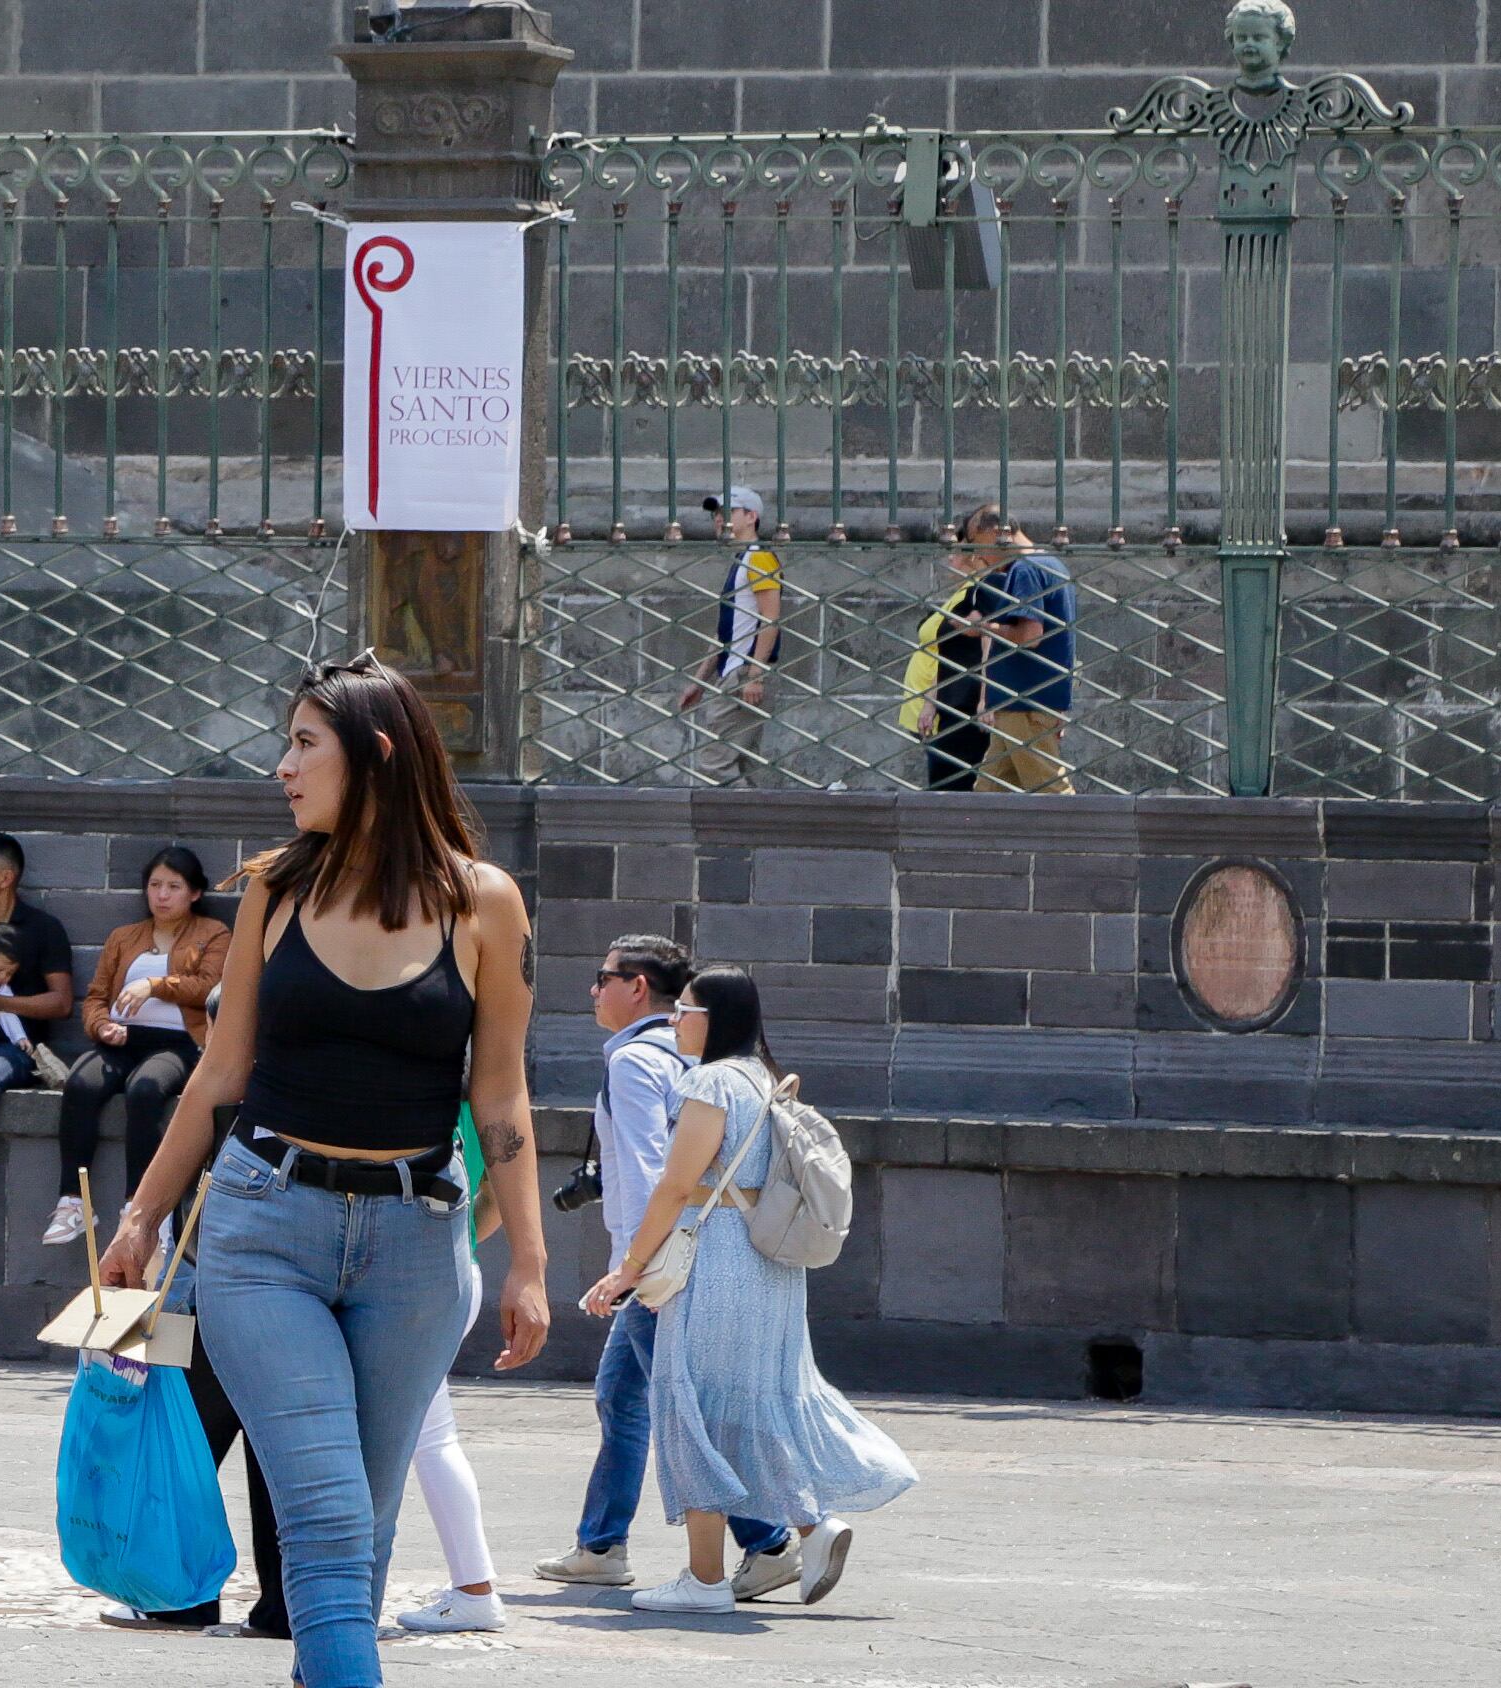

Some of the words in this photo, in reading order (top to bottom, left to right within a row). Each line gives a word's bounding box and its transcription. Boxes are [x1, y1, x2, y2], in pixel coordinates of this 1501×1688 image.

[393, 366, 510, 391] VIERNES
[389, 396, 510, 422] SANTO
[389, 426, 508, 447] PROCESIÓN
